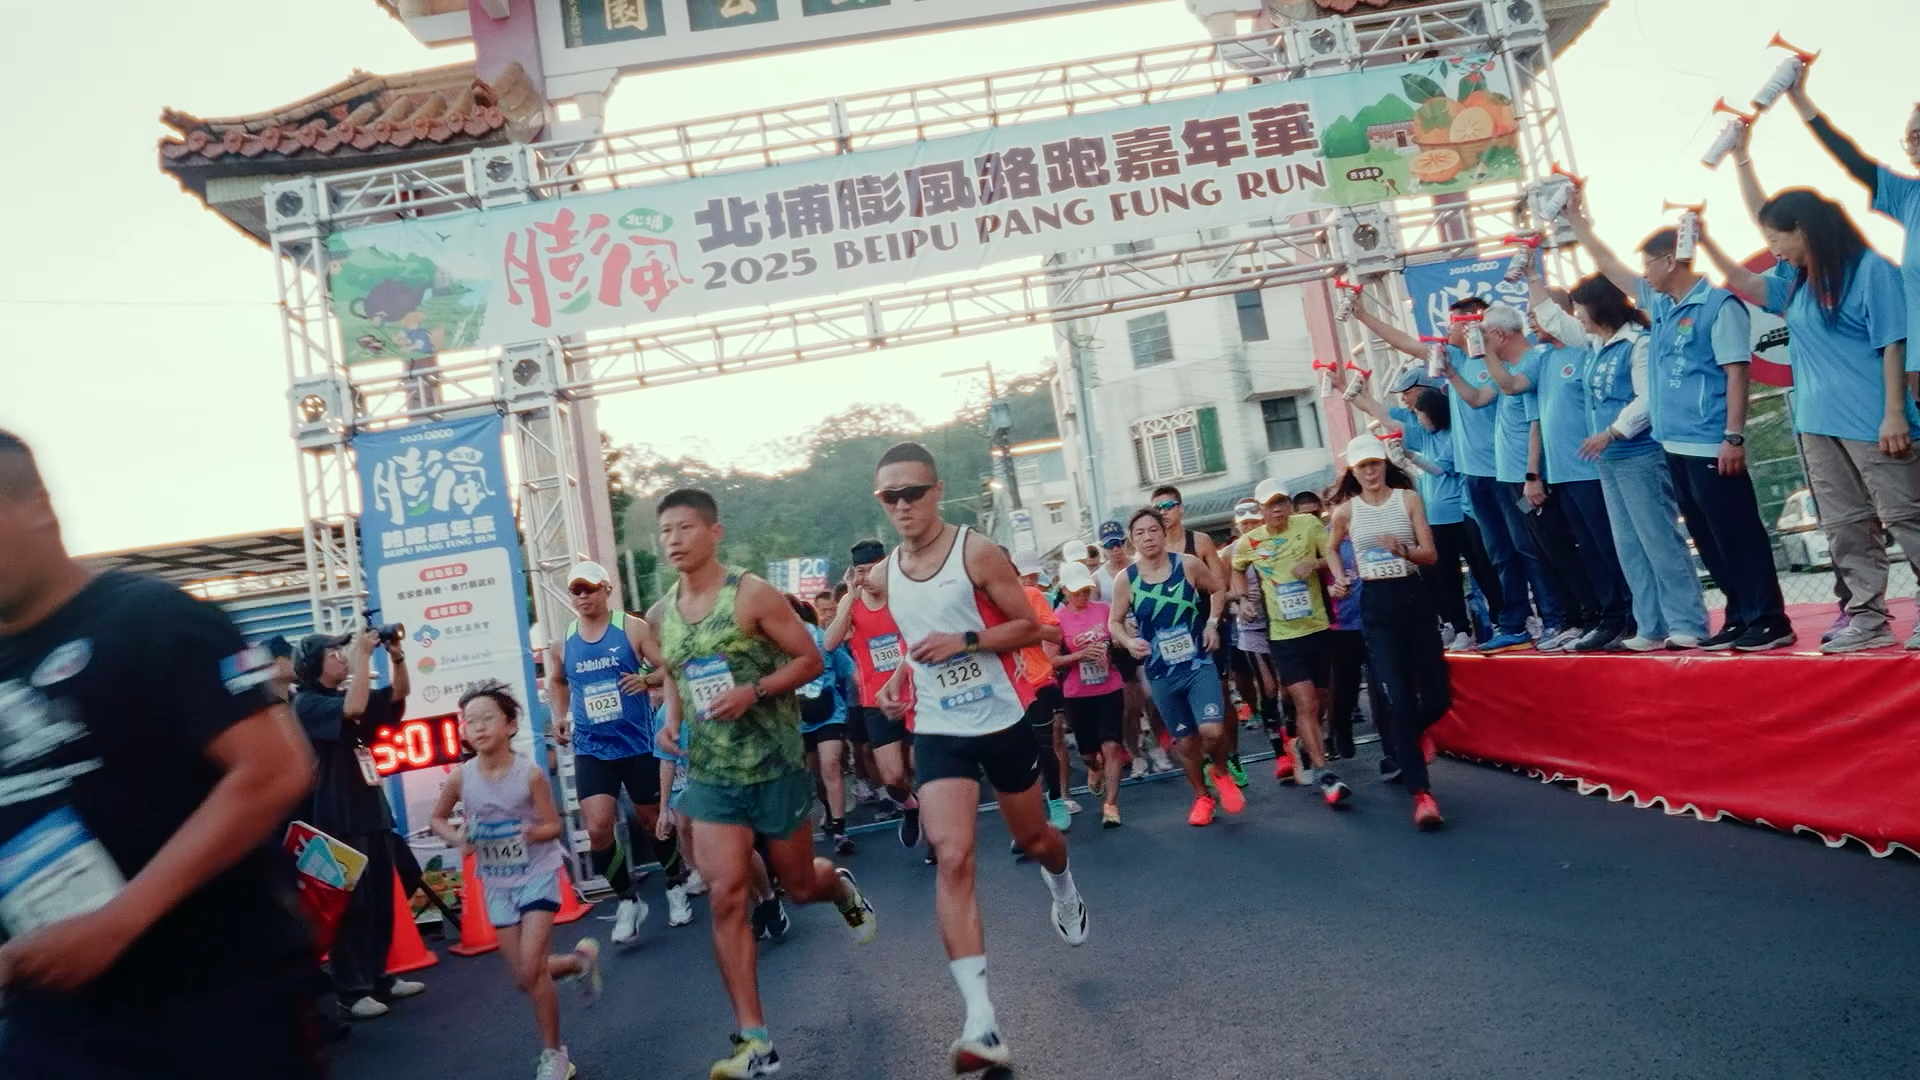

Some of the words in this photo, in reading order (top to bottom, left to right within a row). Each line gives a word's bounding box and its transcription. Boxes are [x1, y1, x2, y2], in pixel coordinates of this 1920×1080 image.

[694, 102, 1320, 253] 北埔膨風路跑嘉年華
[626, 214, 663, 230] 北埔
[703, 254, 818, 291] 2025
[834, 222, 961, 270] BEIPU
[979, 198, 1095, 244] PANG
[1112, 176, 1222, 222] FUNG
[1240, 160, 1328, 201] RUN
[1372, 564, 1403, 577] 1333
[874, 648, 899, 661] 1308
[1164, 639, 1191, 654] 1298
[936, 661, 982, 688] 1328
[588, 696, 618, 711] 1023
[482, 842, 523, 860] 1145
